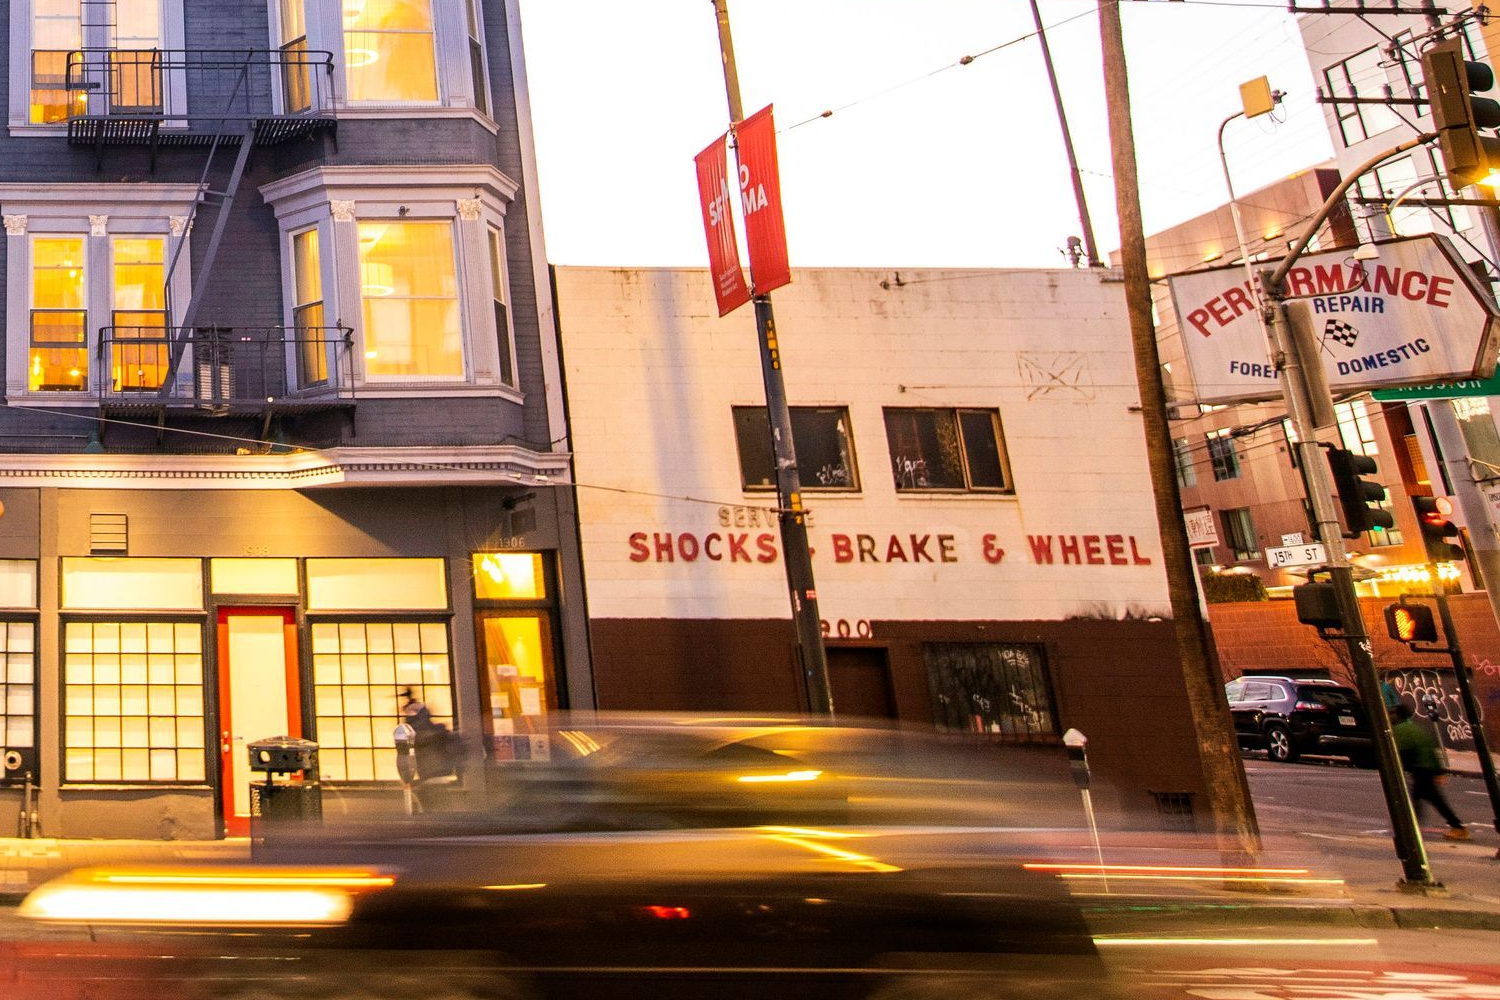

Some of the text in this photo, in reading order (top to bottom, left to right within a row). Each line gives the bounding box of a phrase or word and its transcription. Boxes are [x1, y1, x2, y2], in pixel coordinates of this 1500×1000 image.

[1186, 264, 1454, 338] PERFRMANCE
[1314, 295, 1384, 314] REPAIR
[1337, 338, 1430, 376] DOMESTIC
[628, 532, 1152, 565] SHOCKS BRAKE & WHEEL
[1274, 548, 1318, 563] 15TH ST
